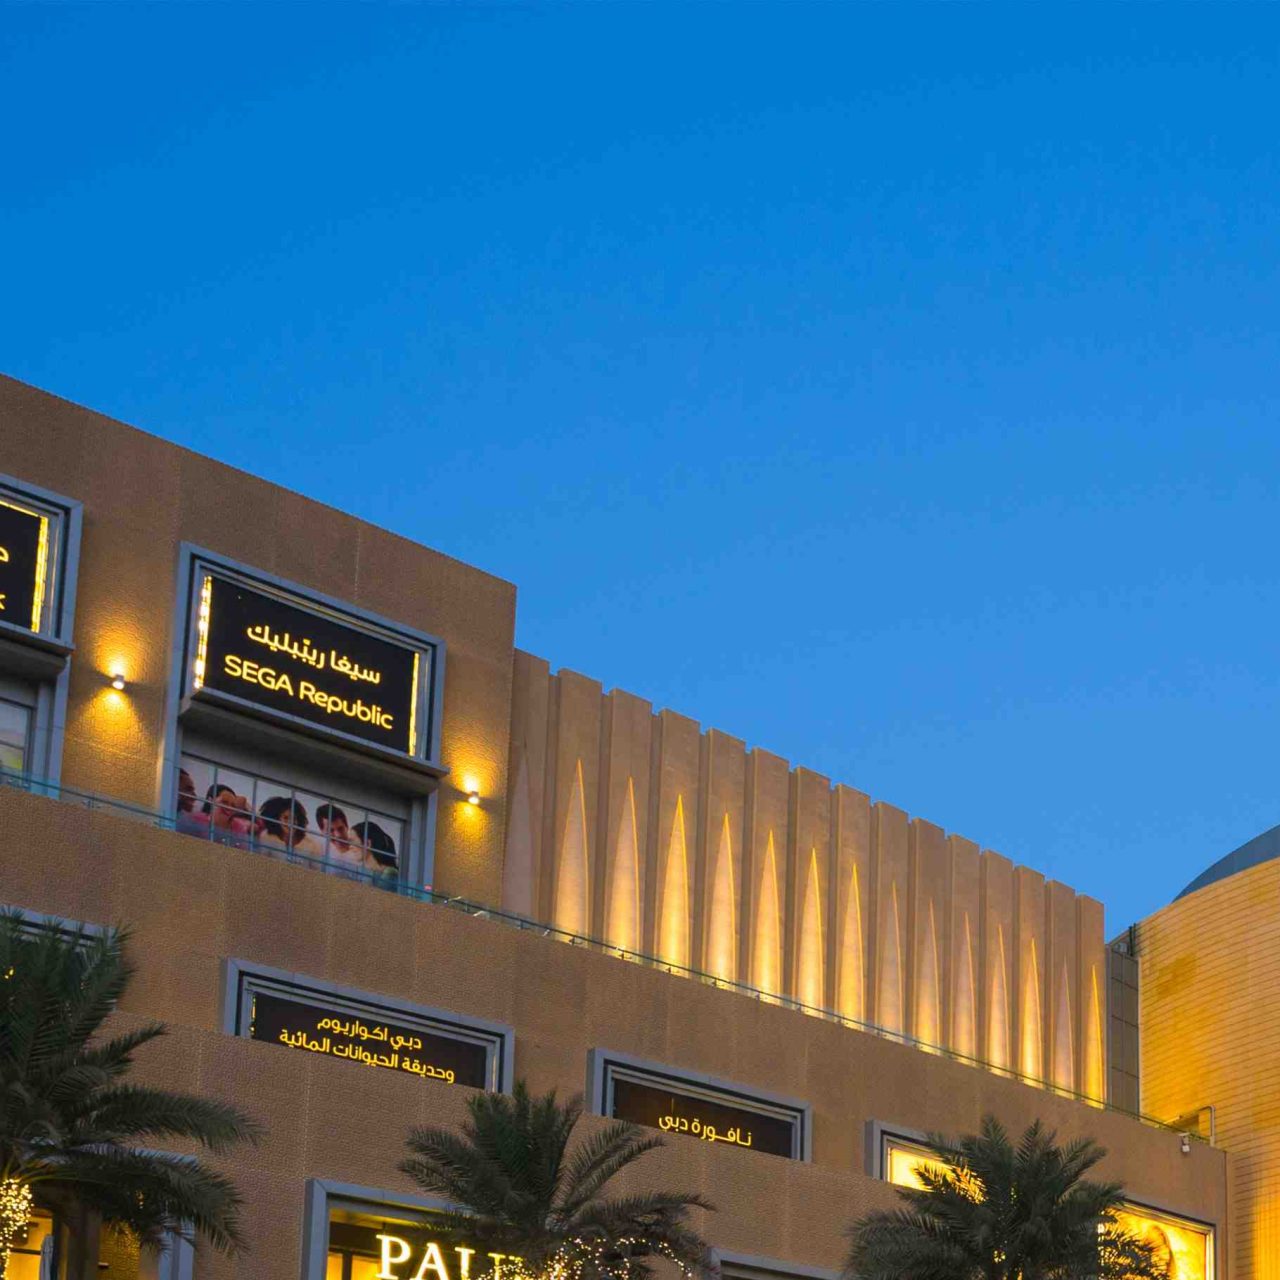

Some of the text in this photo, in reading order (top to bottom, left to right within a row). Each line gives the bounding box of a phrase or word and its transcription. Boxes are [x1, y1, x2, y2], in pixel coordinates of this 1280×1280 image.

[331, 650, 380, 685] سيغا
[224, 655, 393, 729] SEGA Republic
[279, 1029, 455, 1084] وحديقة الحيوانات المائية
[390, 1036, 422, 1051] دبي
[658, 1115, 752, 1146] نافورة دبي
